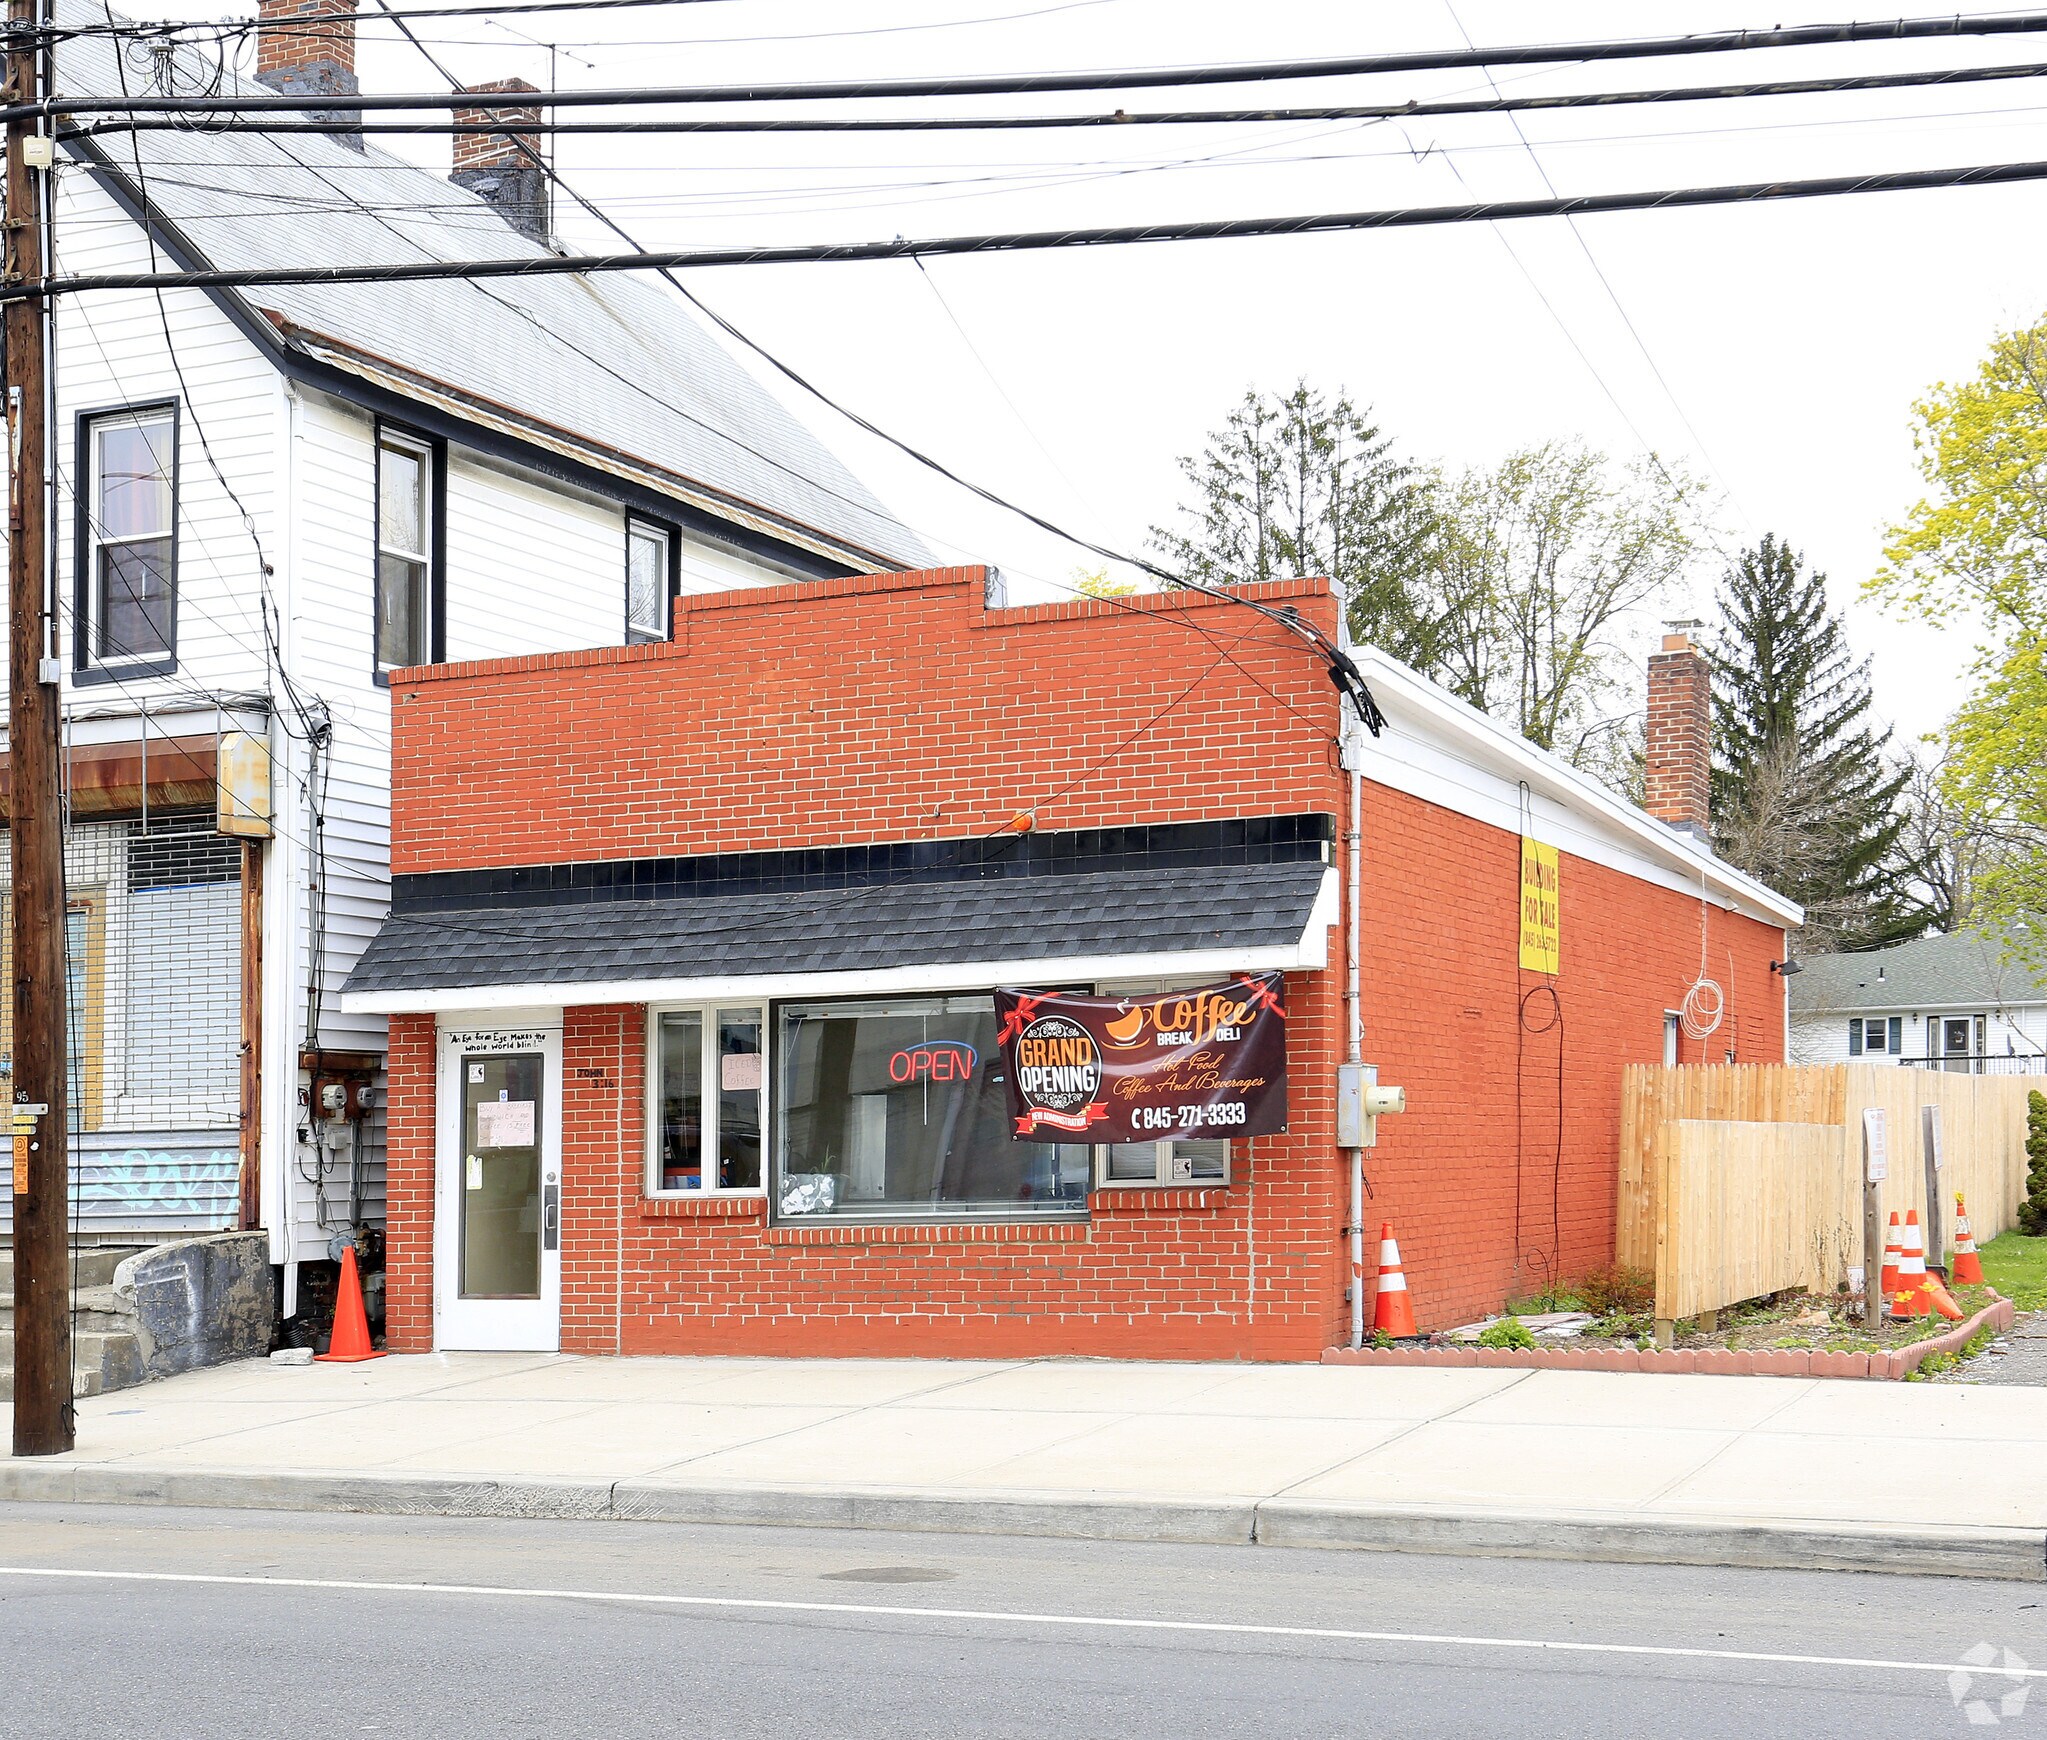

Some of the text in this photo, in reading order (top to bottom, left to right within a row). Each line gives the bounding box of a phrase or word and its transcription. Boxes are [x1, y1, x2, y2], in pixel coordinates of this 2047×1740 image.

[1525, 857, 1555, 892] BUILDING
[1525, 895, 1538, 925] FOR
[1153, 989, 1257, 1045] Coffee
[491, 1041, 514, 1049] world
[493, 1033, 507, 1043] Eye
[1157, 1027, 1241, 1046] BREAK DELI
[1020, 1037, 1092, 1067] GRAND
[1152, 1050, 1225, 1073] Hot Food
[577, 1068, 603, 1078] JOHN
[890, 1050, 972, 1082] OPEN
[591, 1079, 614, 1088] 3:16
[1020, 1066, 1095, 1093] OPENING
[1113, 1070, 1265, 1100] Coffee And Beverages
[16, 1090, 29, 1103] 95
[1031, 1111, 1087, 1127] NEW ADMINISTRATION
[1144, 1102, 1246, 1129] 845-271-3333
